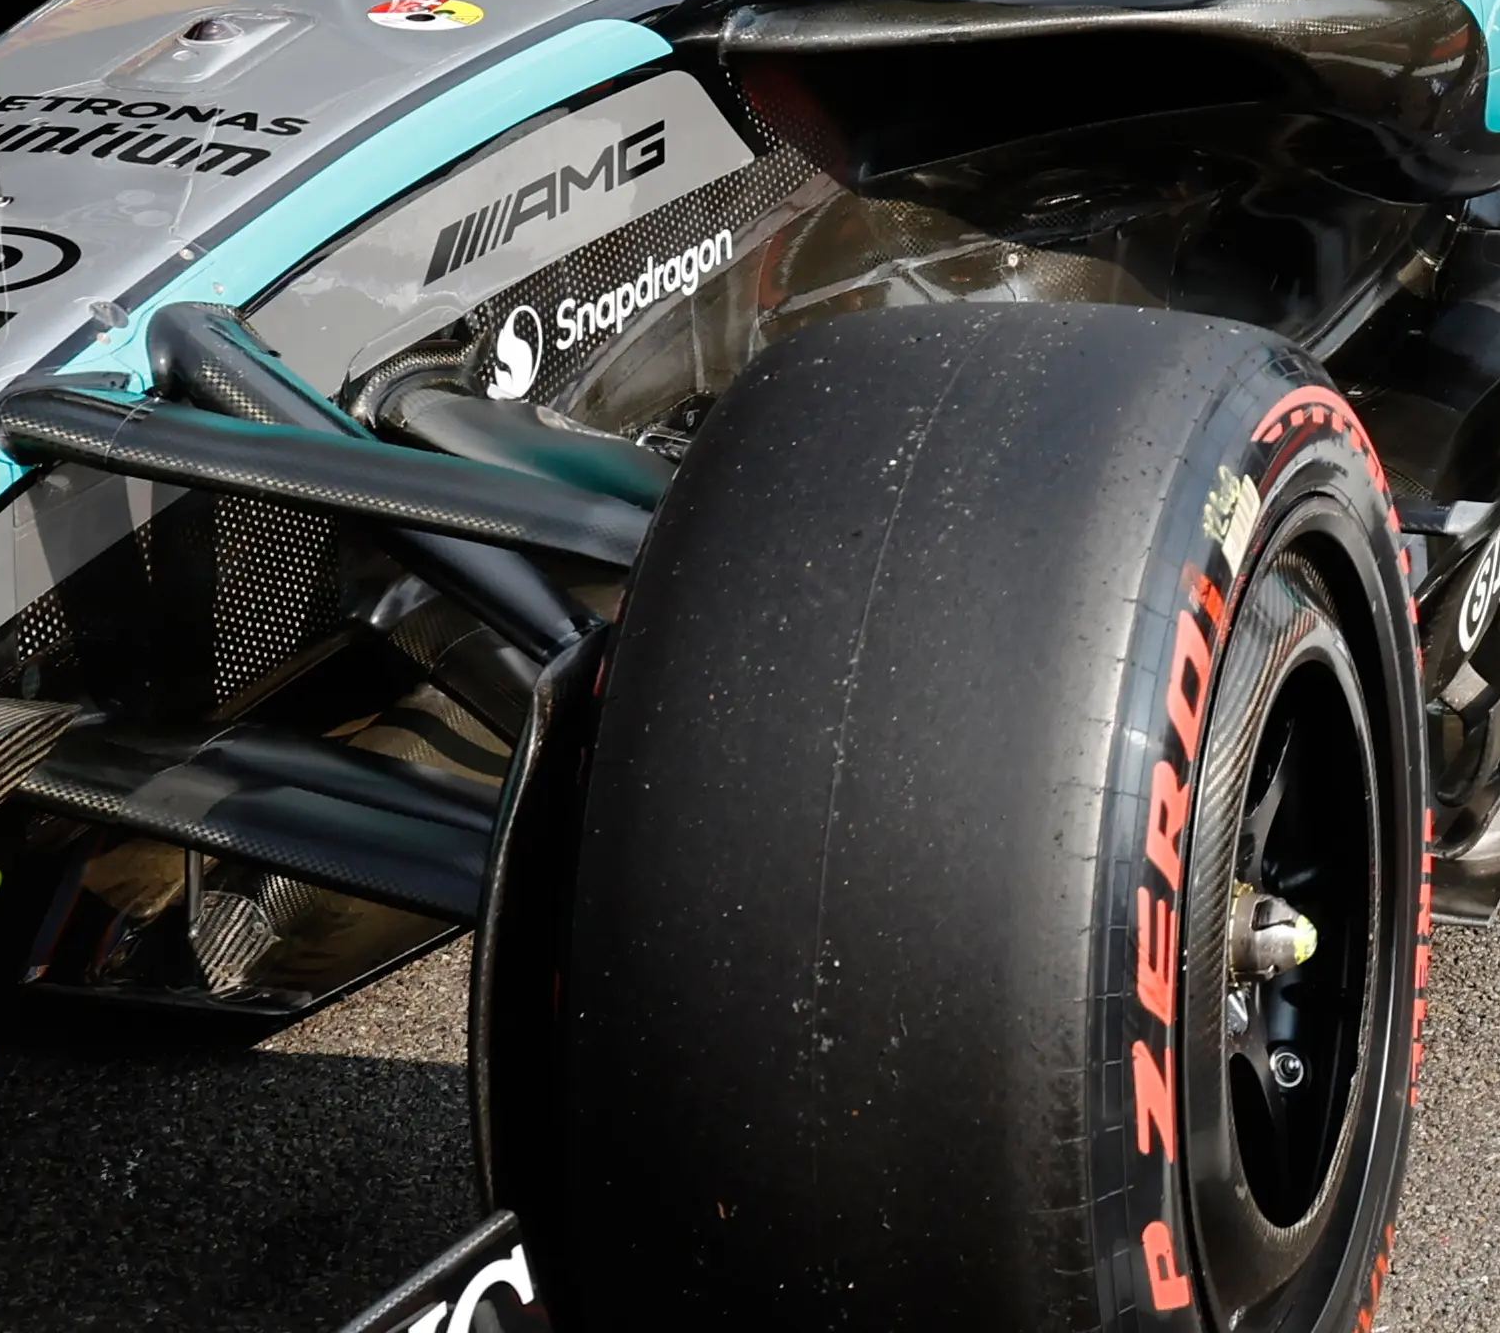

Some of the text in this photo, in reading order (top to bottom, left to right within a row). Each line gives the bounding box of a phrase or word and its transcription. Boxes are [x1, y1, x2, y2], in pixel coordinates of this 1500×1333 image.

[555, 227, 733, 352] Snapdragon
[1131, 609, 1220, 1312] P ZERO
